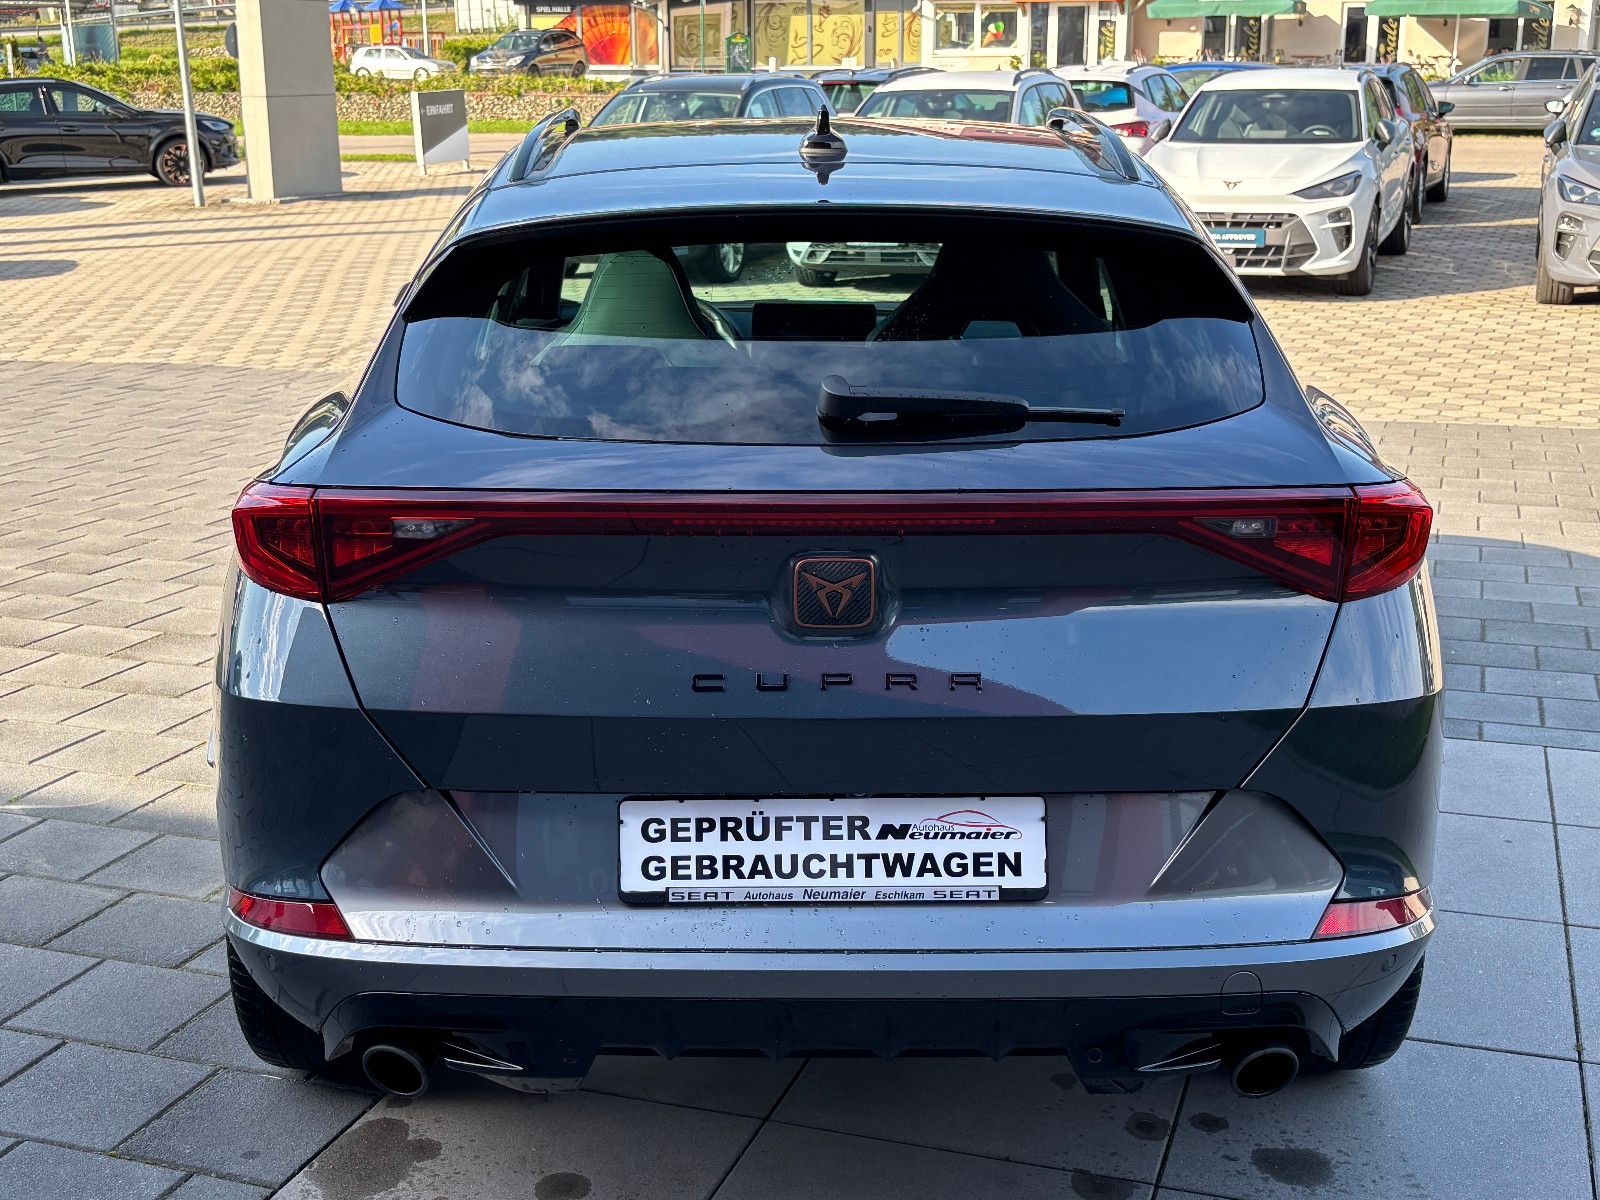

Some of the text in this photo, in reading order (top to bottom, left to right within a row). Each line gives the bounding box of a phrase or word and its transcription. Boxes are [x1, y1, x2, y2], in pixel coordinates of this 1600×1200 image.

[425, 103, 454, 116] EINFAHRT
[691, 672, 983, 692] CUPRA
[640, 811, 872, 843] GEPRÜFTER
[874, 823, 1018, 841] Neumaier
[911, 823, 955, 832] Autohaus
[640, 851, 1022, 881] GEBRAUCHTWAGEN
[671, 888, 997, 901] SEAT Autohaus Neumaier Eschlkam SEAT
